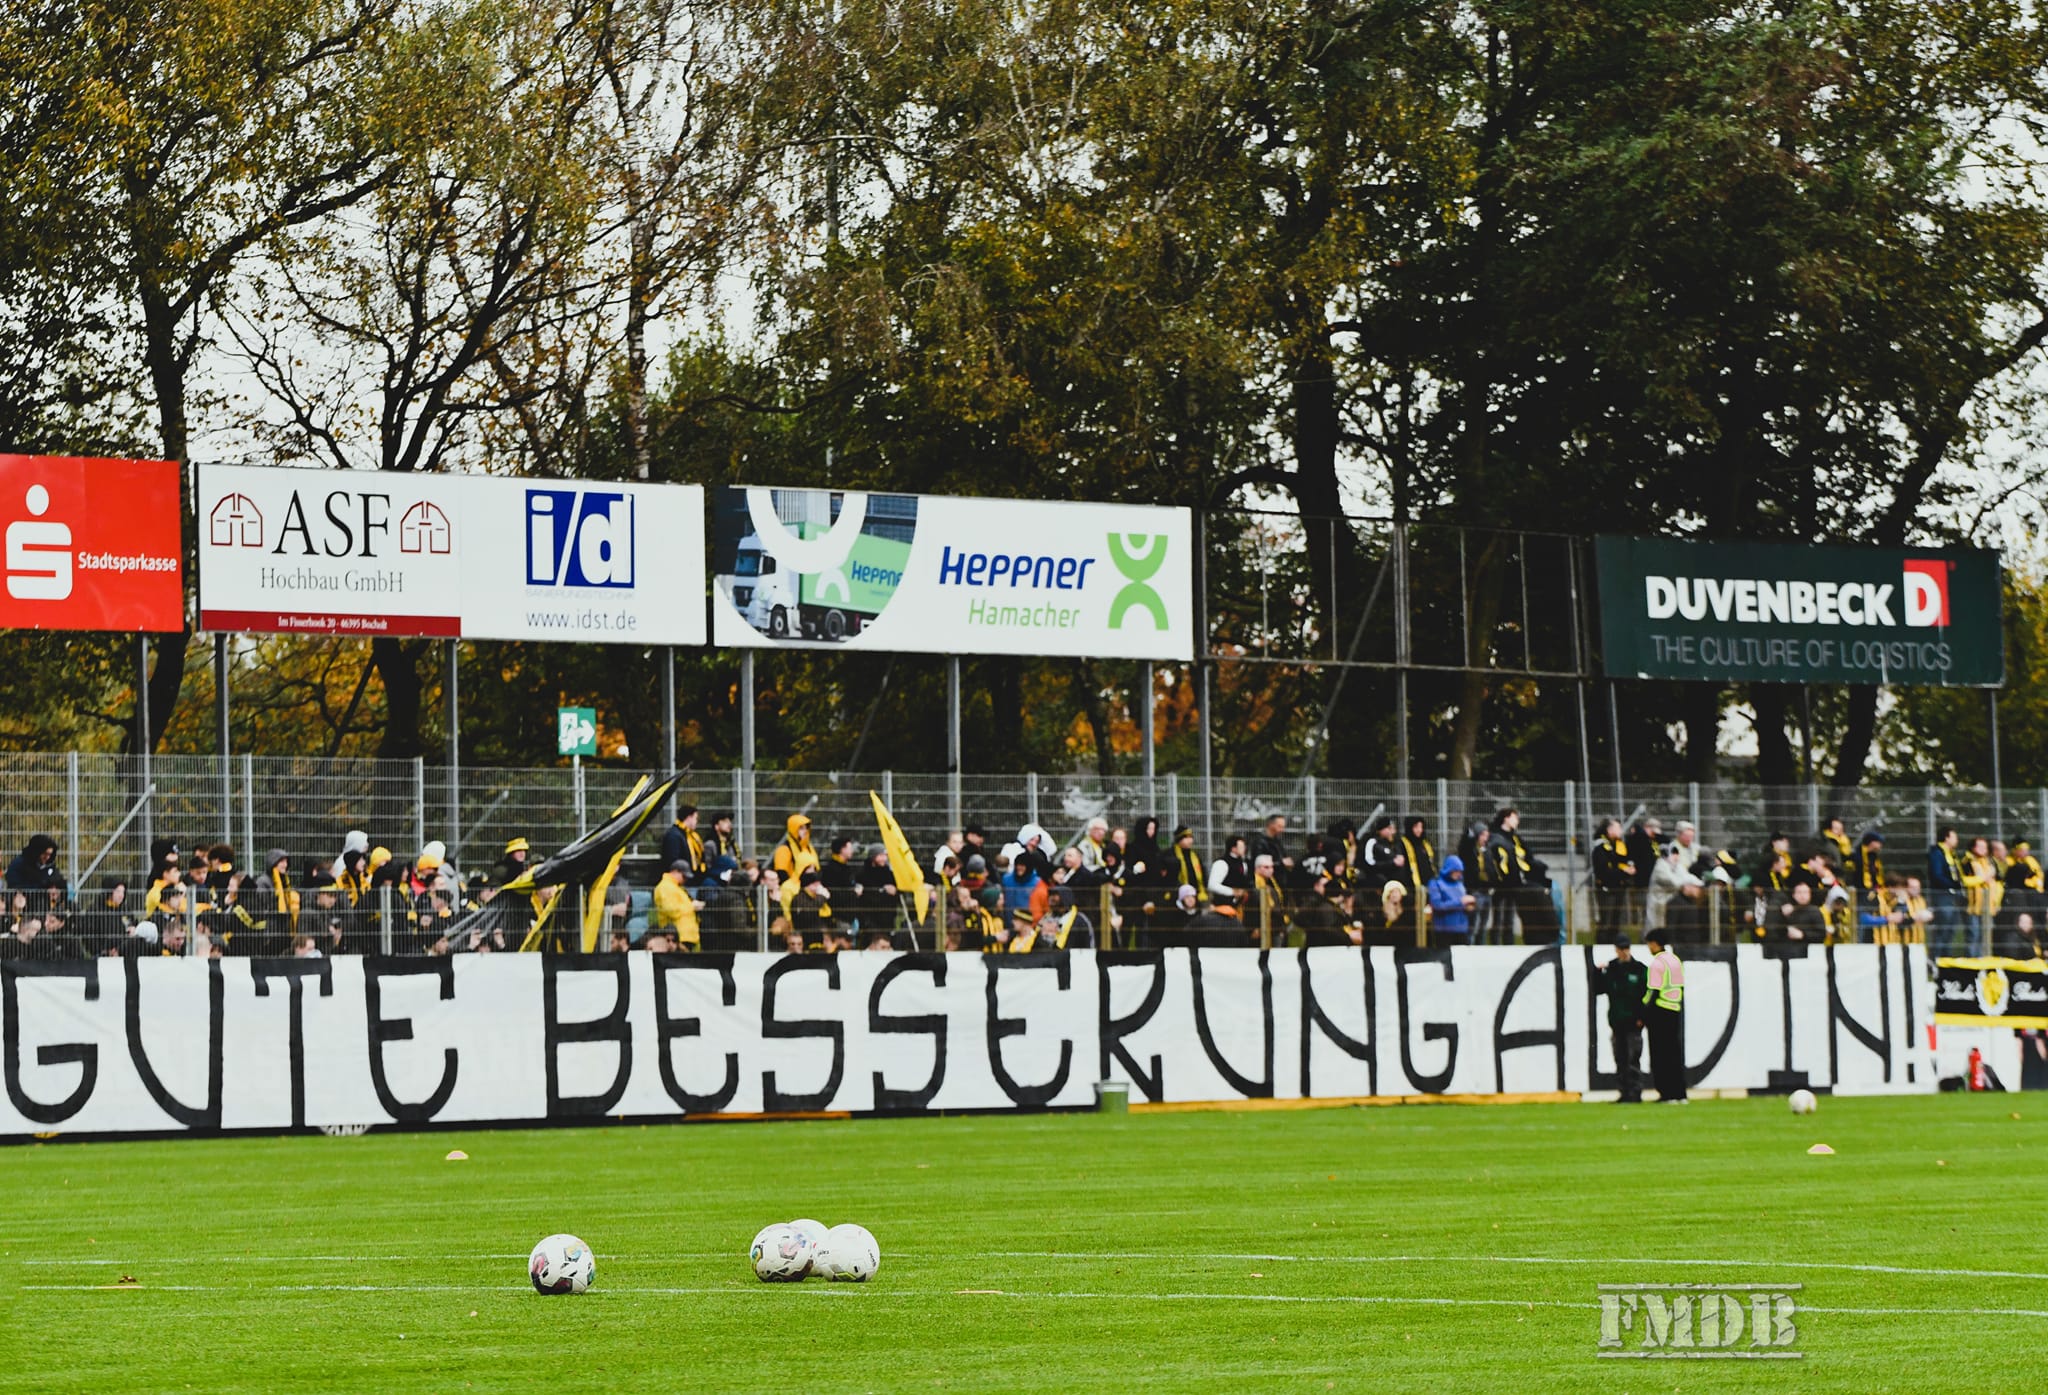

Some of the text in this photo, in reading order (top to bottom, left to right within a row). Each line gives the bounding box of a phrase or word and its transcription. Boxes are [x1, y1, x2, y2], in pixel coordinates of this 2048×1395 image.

[271, 489, 391, 558] ASF
[78, 551, 177, 574] Stadtsparkasse
[261, 566, 404, 593] Hochbau GmbH
[968, 598, 1081, 629] Hamacher
[1645, 571, 1943, 627] DUVENBECK D
[526, 609, 637, 631] www.idst.de
[1651, 634, 1952, 671] THE CULTURE OF LOGISTICS
[1, 956, 459, 1128] GUTE
[542, 945, 1459, 1117] BESSERUNG
